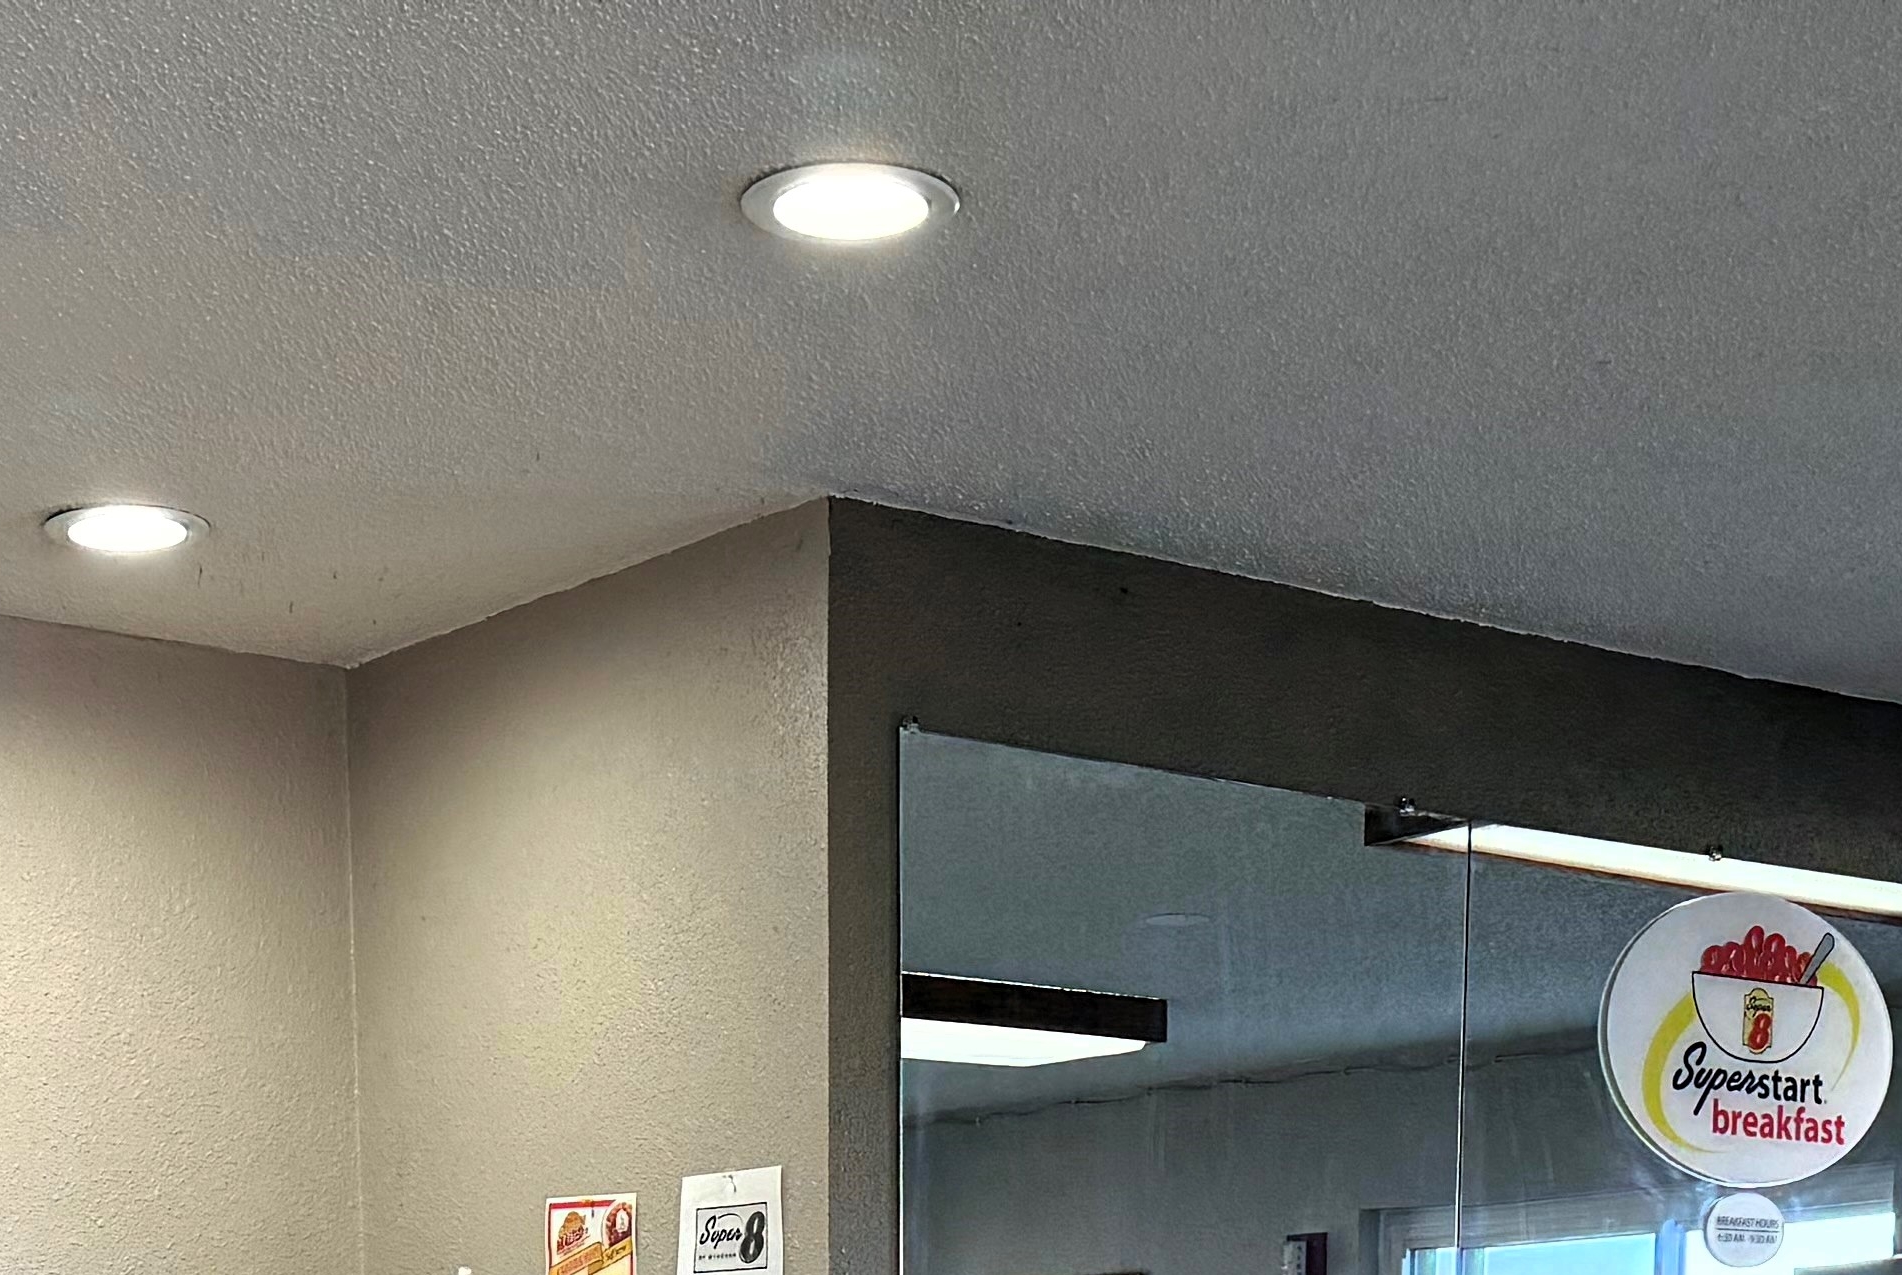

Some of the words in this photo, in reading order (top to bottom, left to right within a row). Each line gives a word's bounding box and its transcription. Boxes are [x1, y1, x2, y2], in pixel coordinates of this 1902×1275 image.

[1748, 1012, 1772, 1050] 8
[1672, 1041, 1824, 1116] Superstart
[1712, 1098, 1846, 1146] breakfast
[699, 1215, 744, 1250] Super
[739, 1211, 766, 1264] 8
